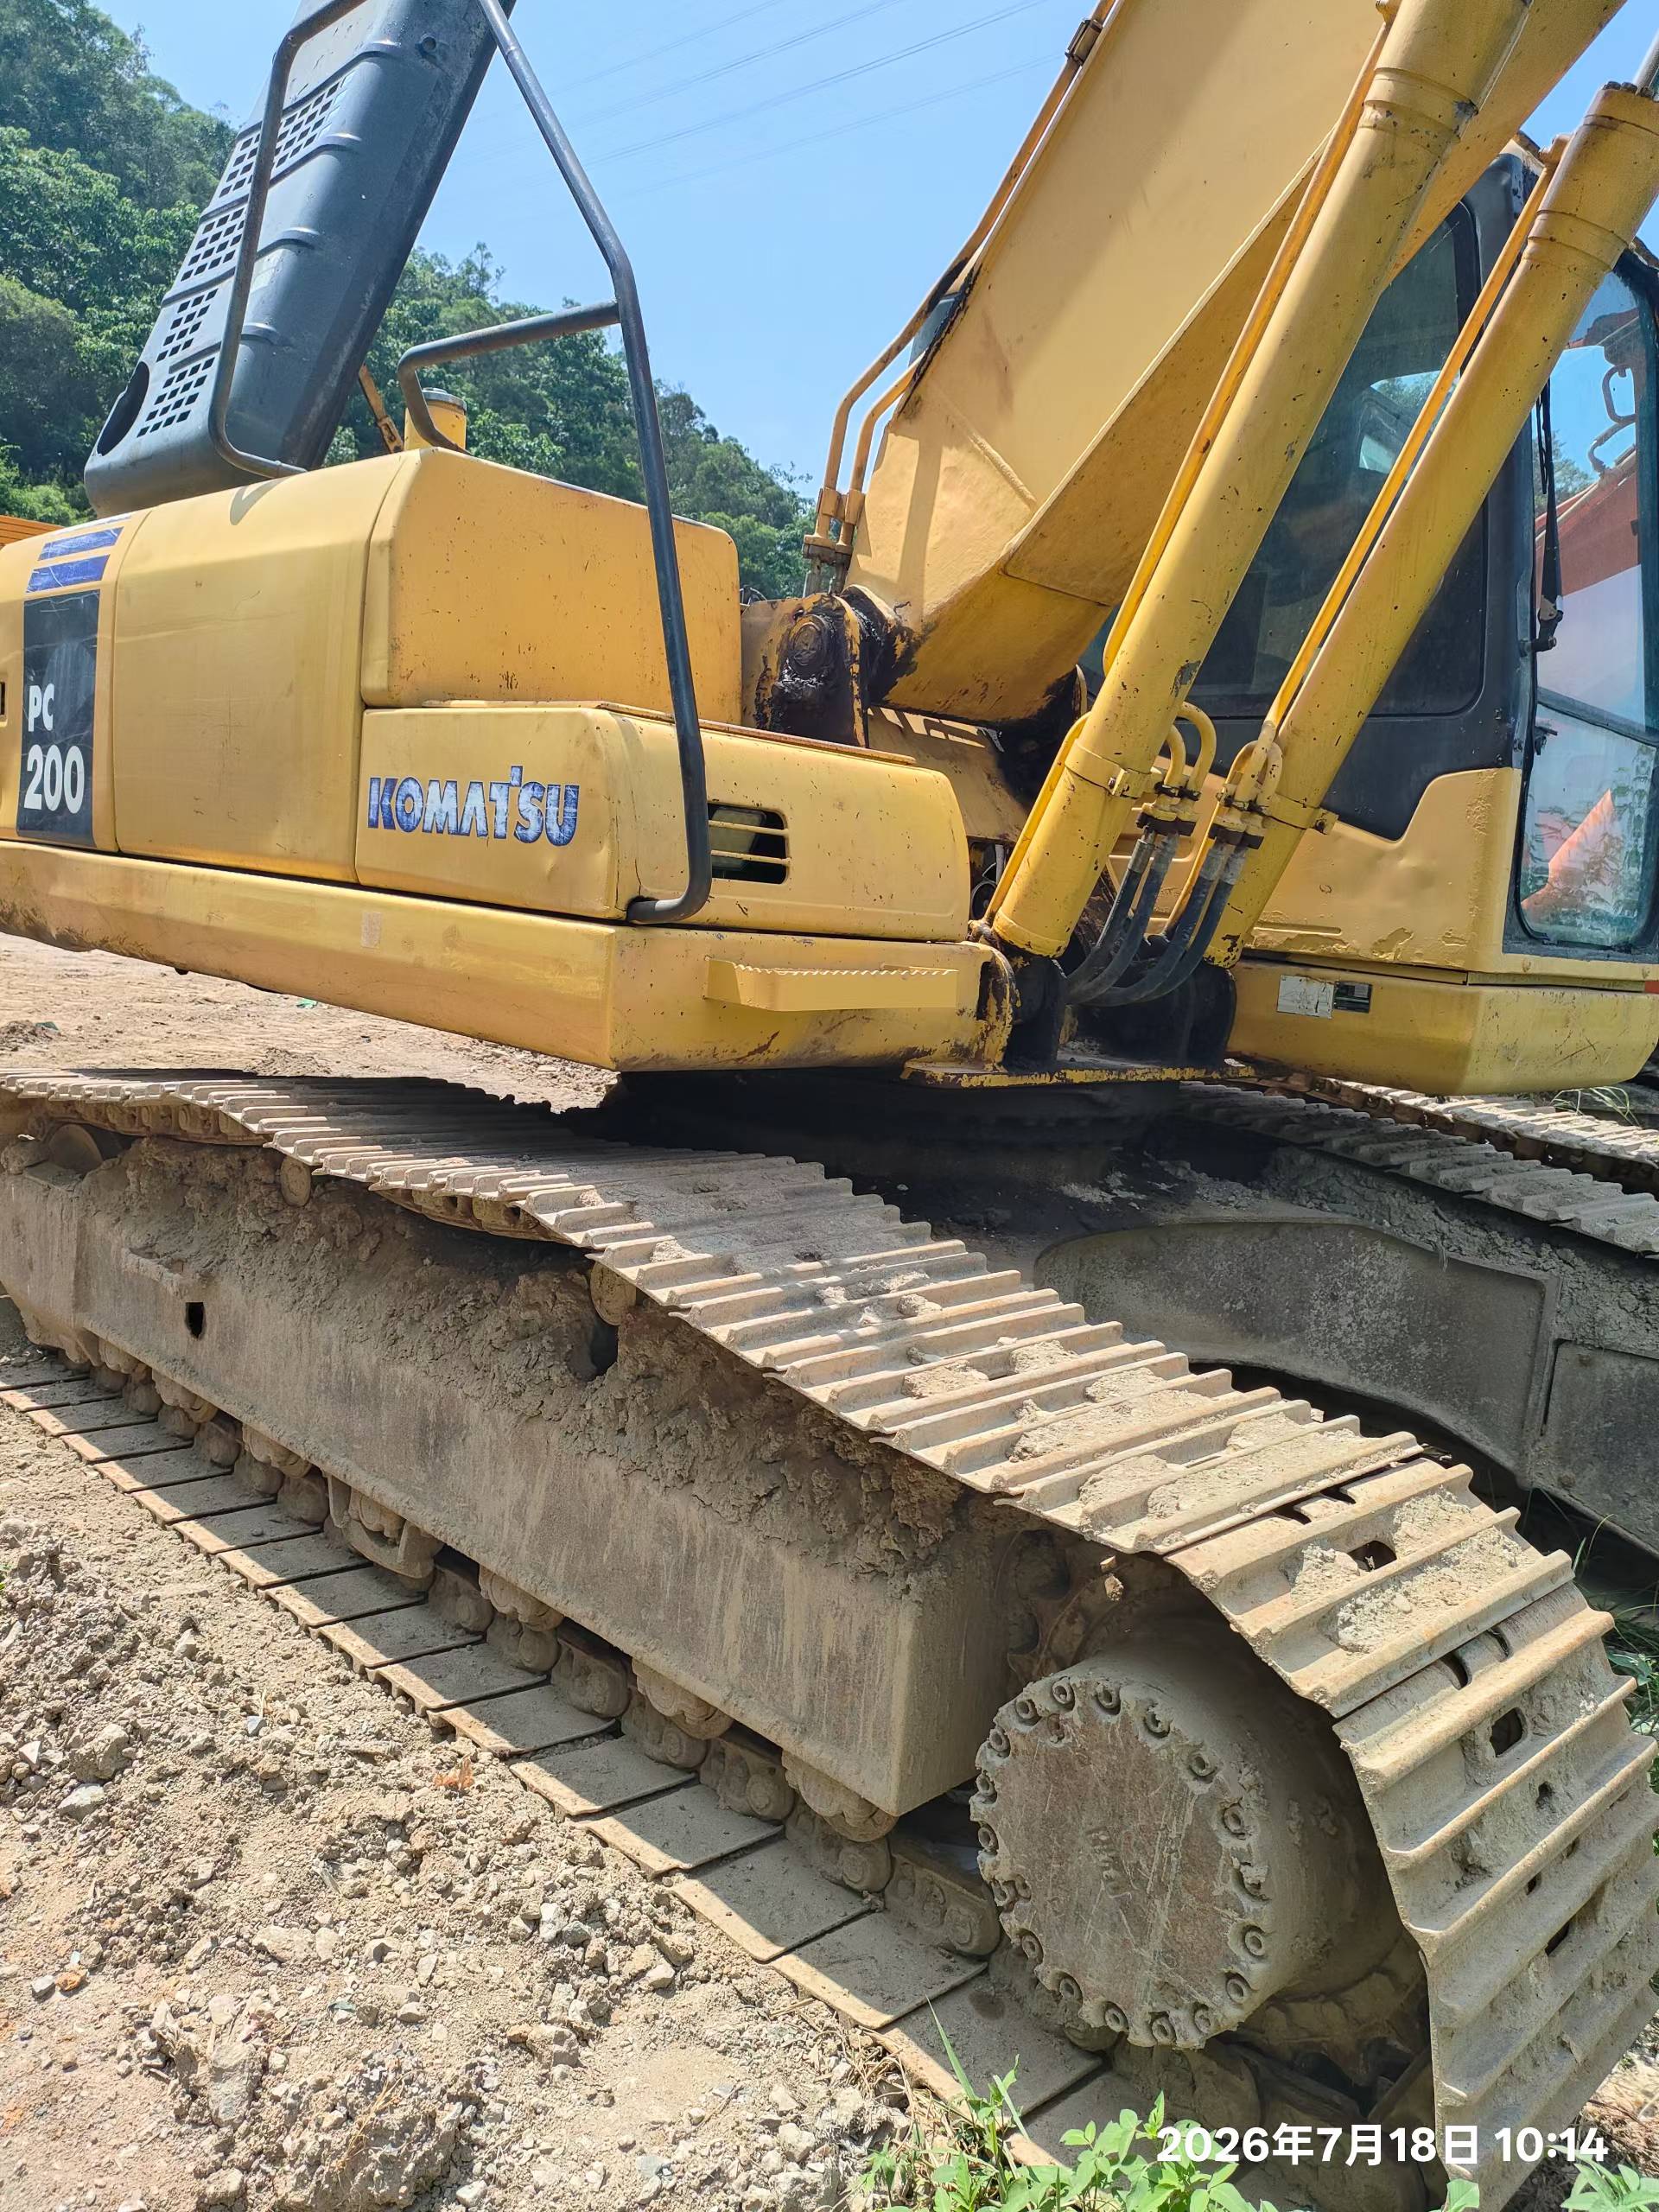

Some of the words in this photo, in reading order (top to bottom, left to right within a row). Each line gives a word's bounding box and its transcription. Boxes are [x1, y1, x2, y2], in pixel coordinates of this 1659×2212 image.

[28, 683, 54, 733] PC
[23, 744, 85, 814] 200
[367, 766, 580, 847] KOMATSU
